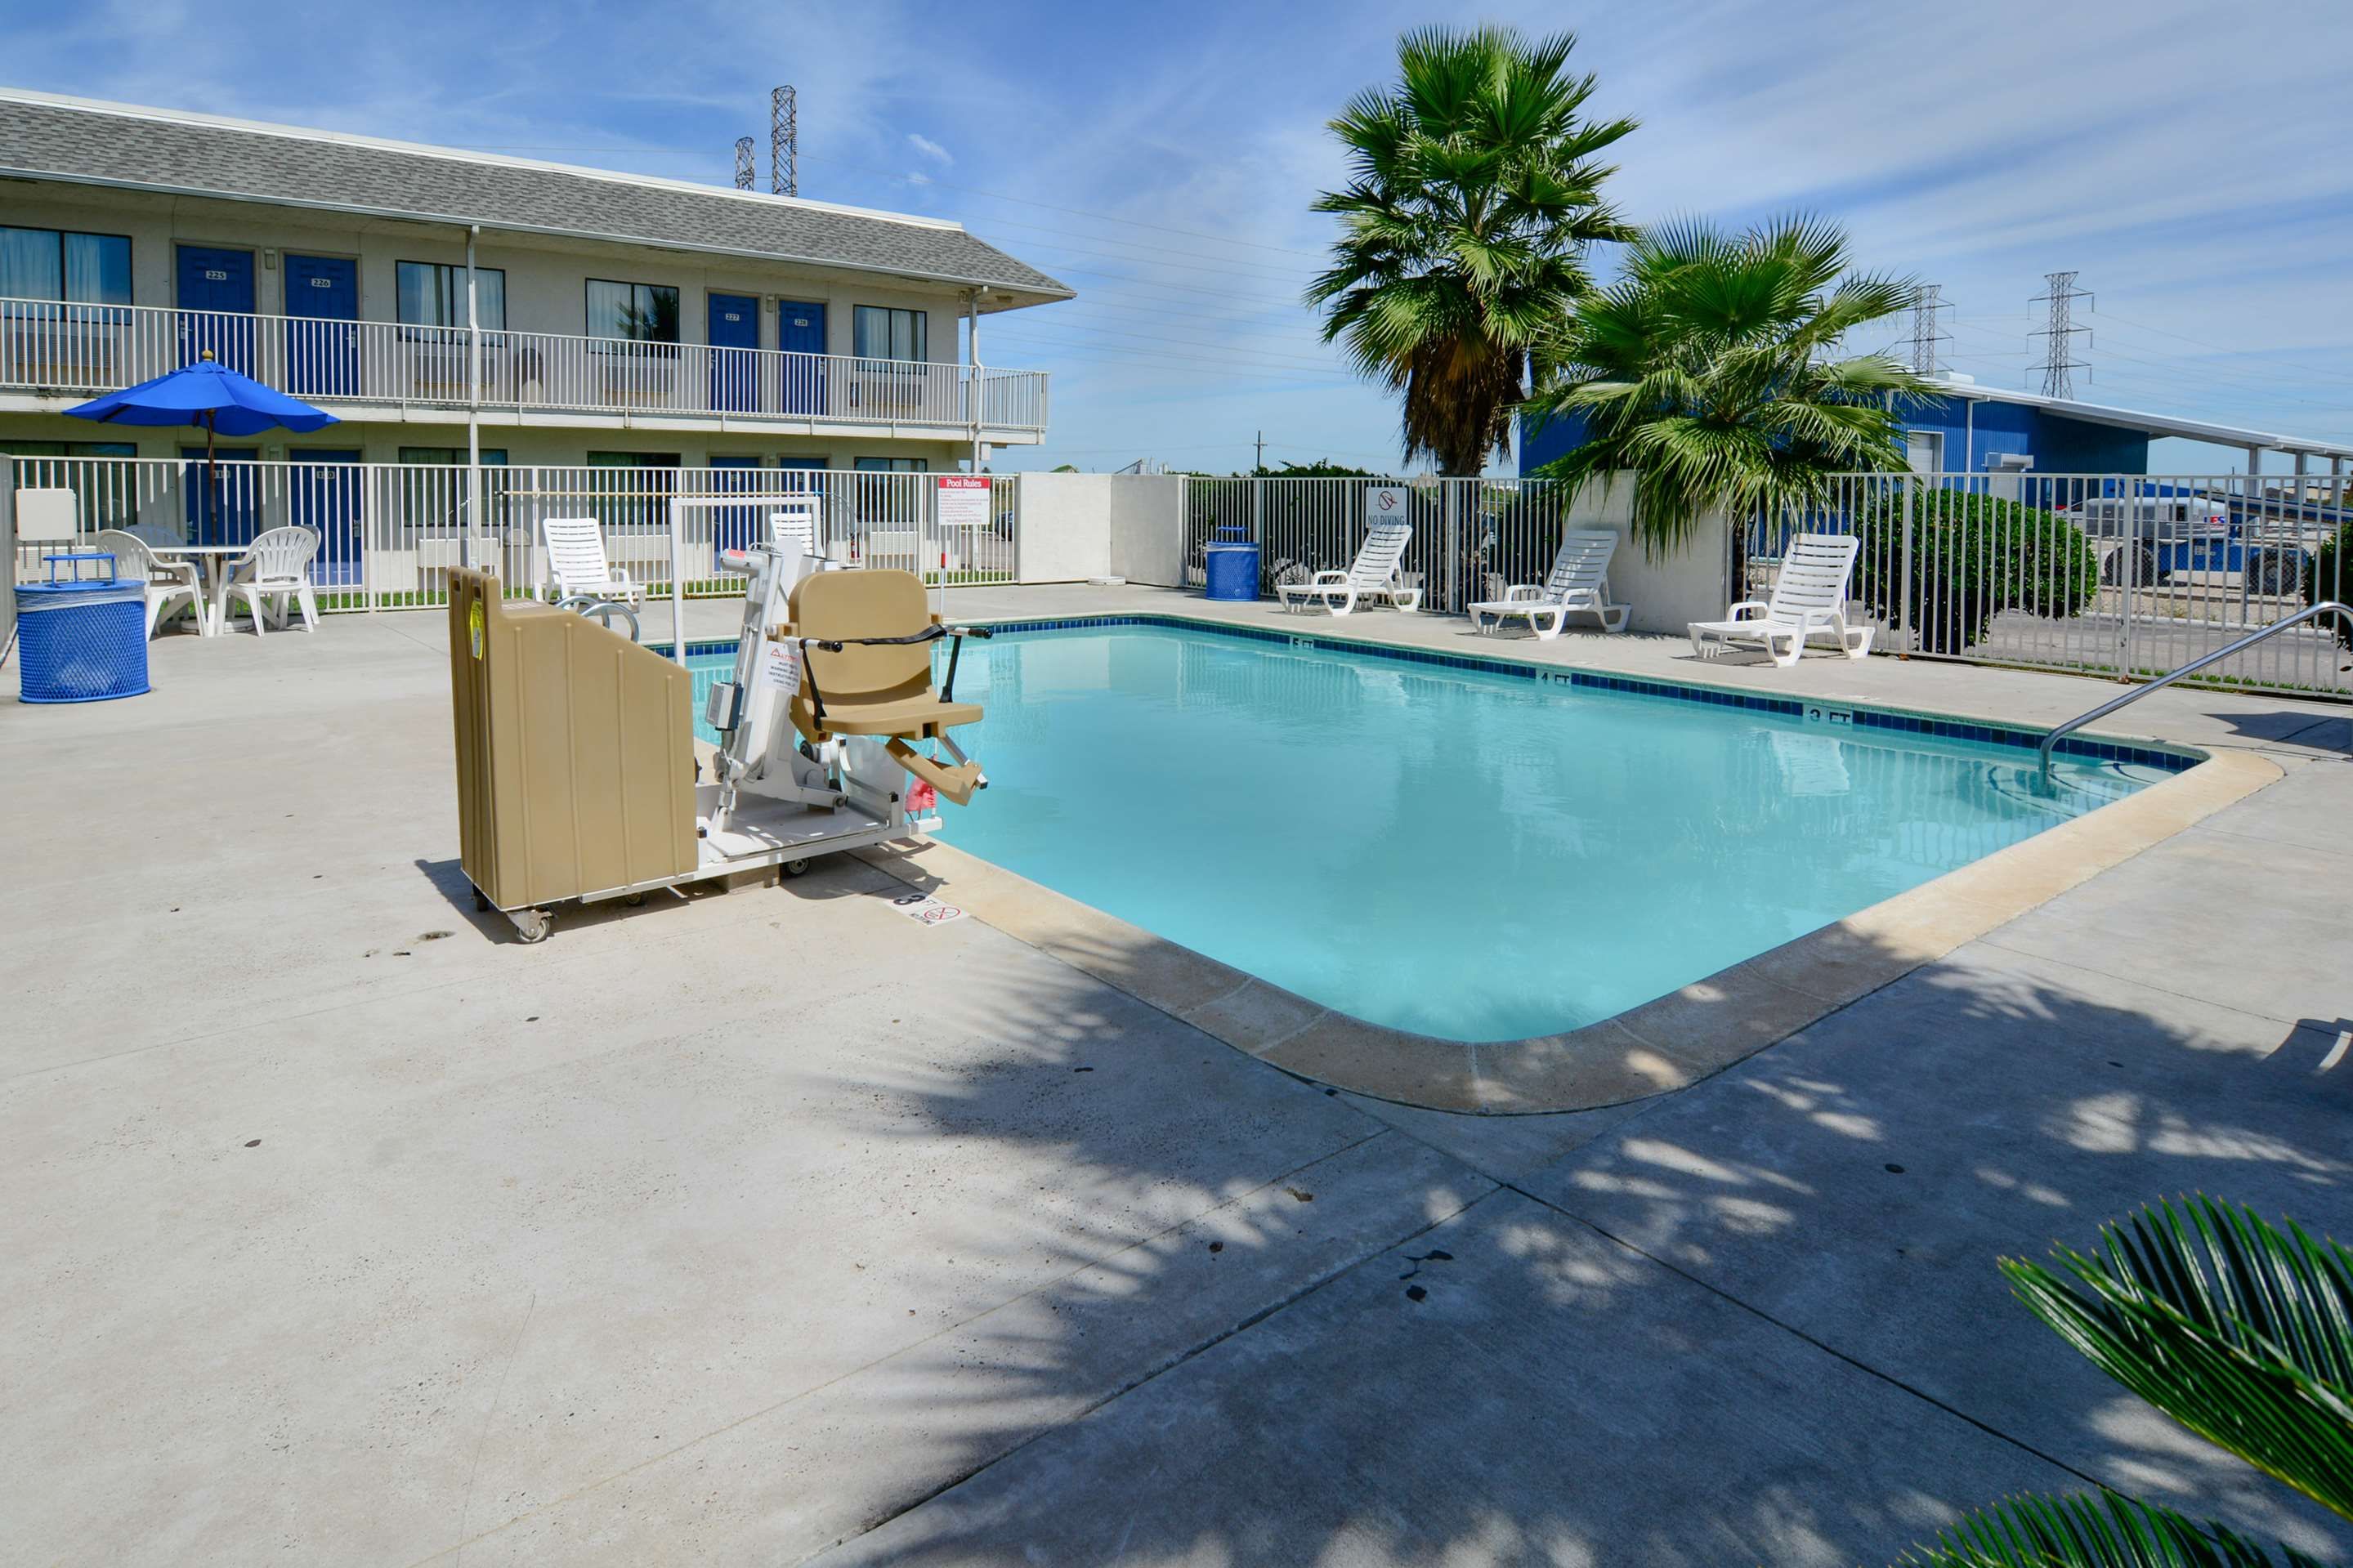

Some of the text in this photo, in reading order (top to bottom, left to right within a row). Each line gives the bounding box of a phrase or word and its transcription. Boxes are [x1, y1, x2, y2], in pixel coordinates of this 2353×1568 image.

[208, 271, 225, 279] 225
[946, 479, 982, 488] Pool Rules
[1368, 515, 1405, 525] NO DIVING
[893, 895, 925, 905] 3
